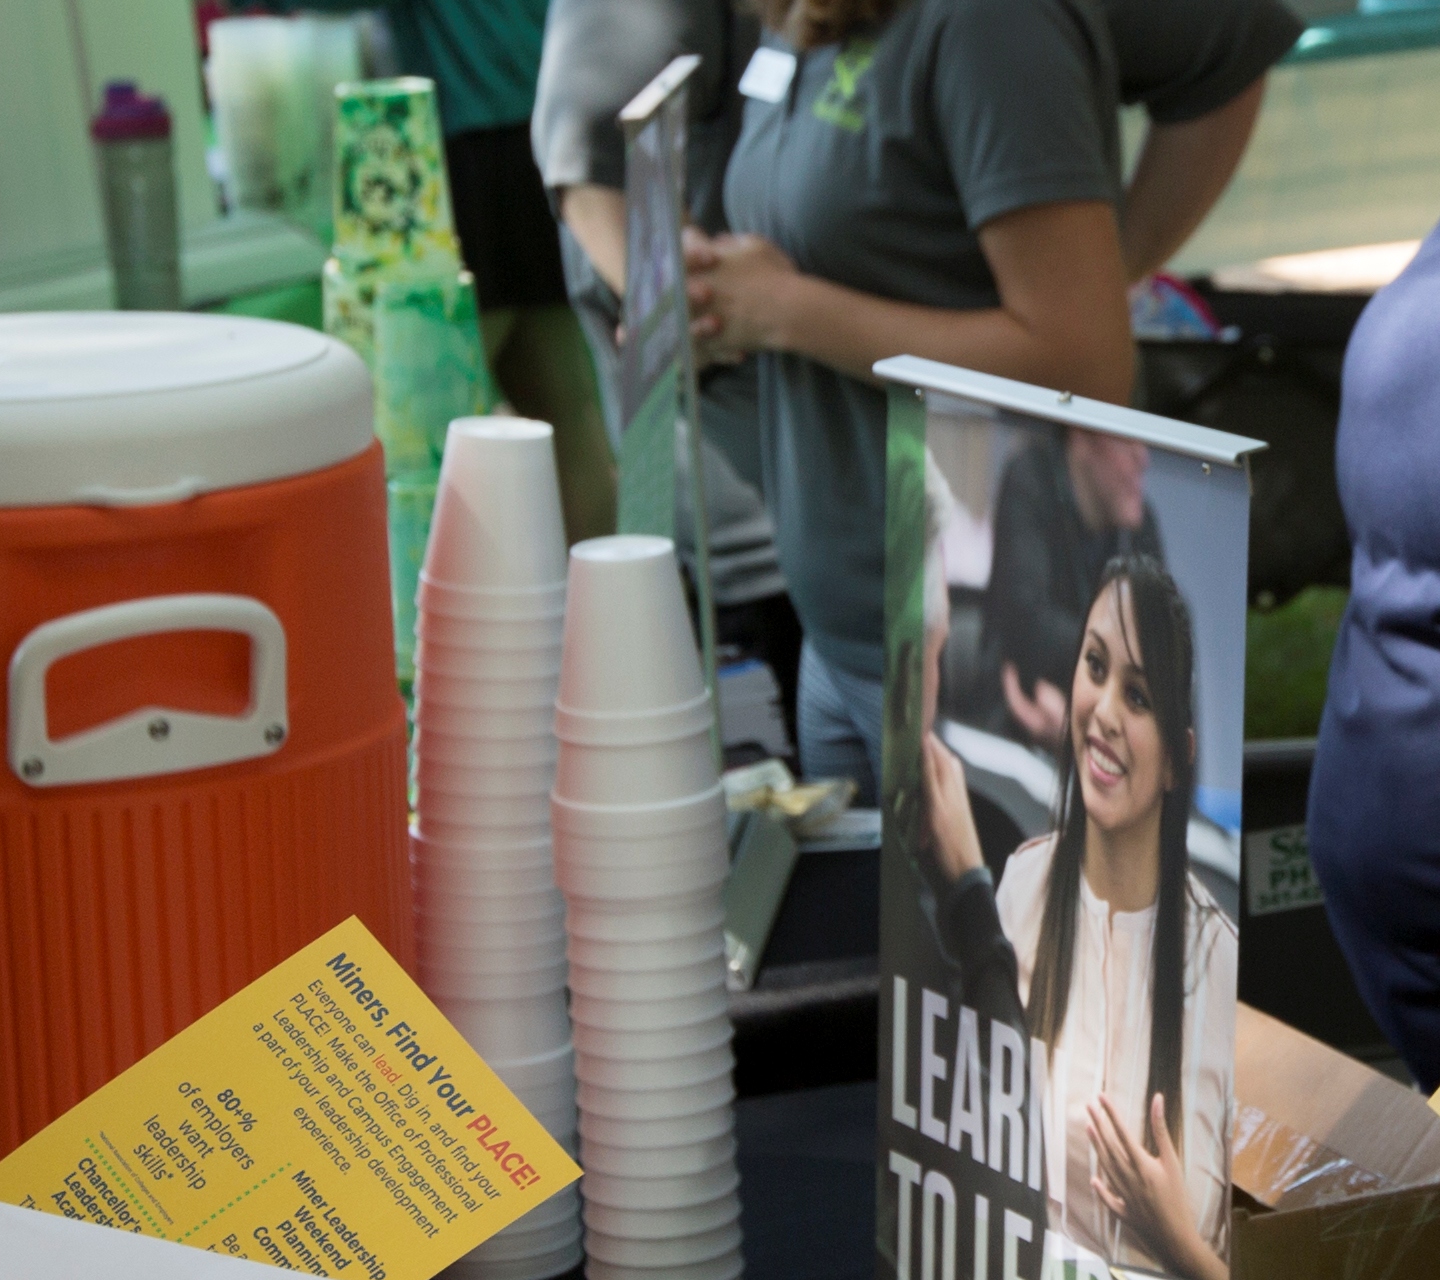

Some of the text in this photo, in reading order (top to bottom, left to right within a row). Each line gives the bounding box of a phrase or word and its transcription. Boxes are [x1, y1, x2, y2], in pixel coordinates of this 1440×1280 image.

[177, 1081, 254, 1169] of employers
[216, 1088, 257, 1132] 80+%
[272, 1009, 457, 1223] Leadership and Campus Engagement
[289, 992, 482, 1212] PLACE! Make the Office of Professional
[307, 979, 501, 1199] Everyone can lead. Dig in, and find your
[326, 952, 539, 1189] Miners, Find Your PLACE!
[892, 977, 1064, 1202] LEARN
[143, 1114, 206, 1189] leadership
[178, 1119, 214, 1159] want
[252, 1022, 439, 1238] a part of your leadership development
[293, 1107, 350, 1174] experience.
[291, 1169, 385, 1280] Miner Leadership
[294, 1205, 351, 1270] Weekend
